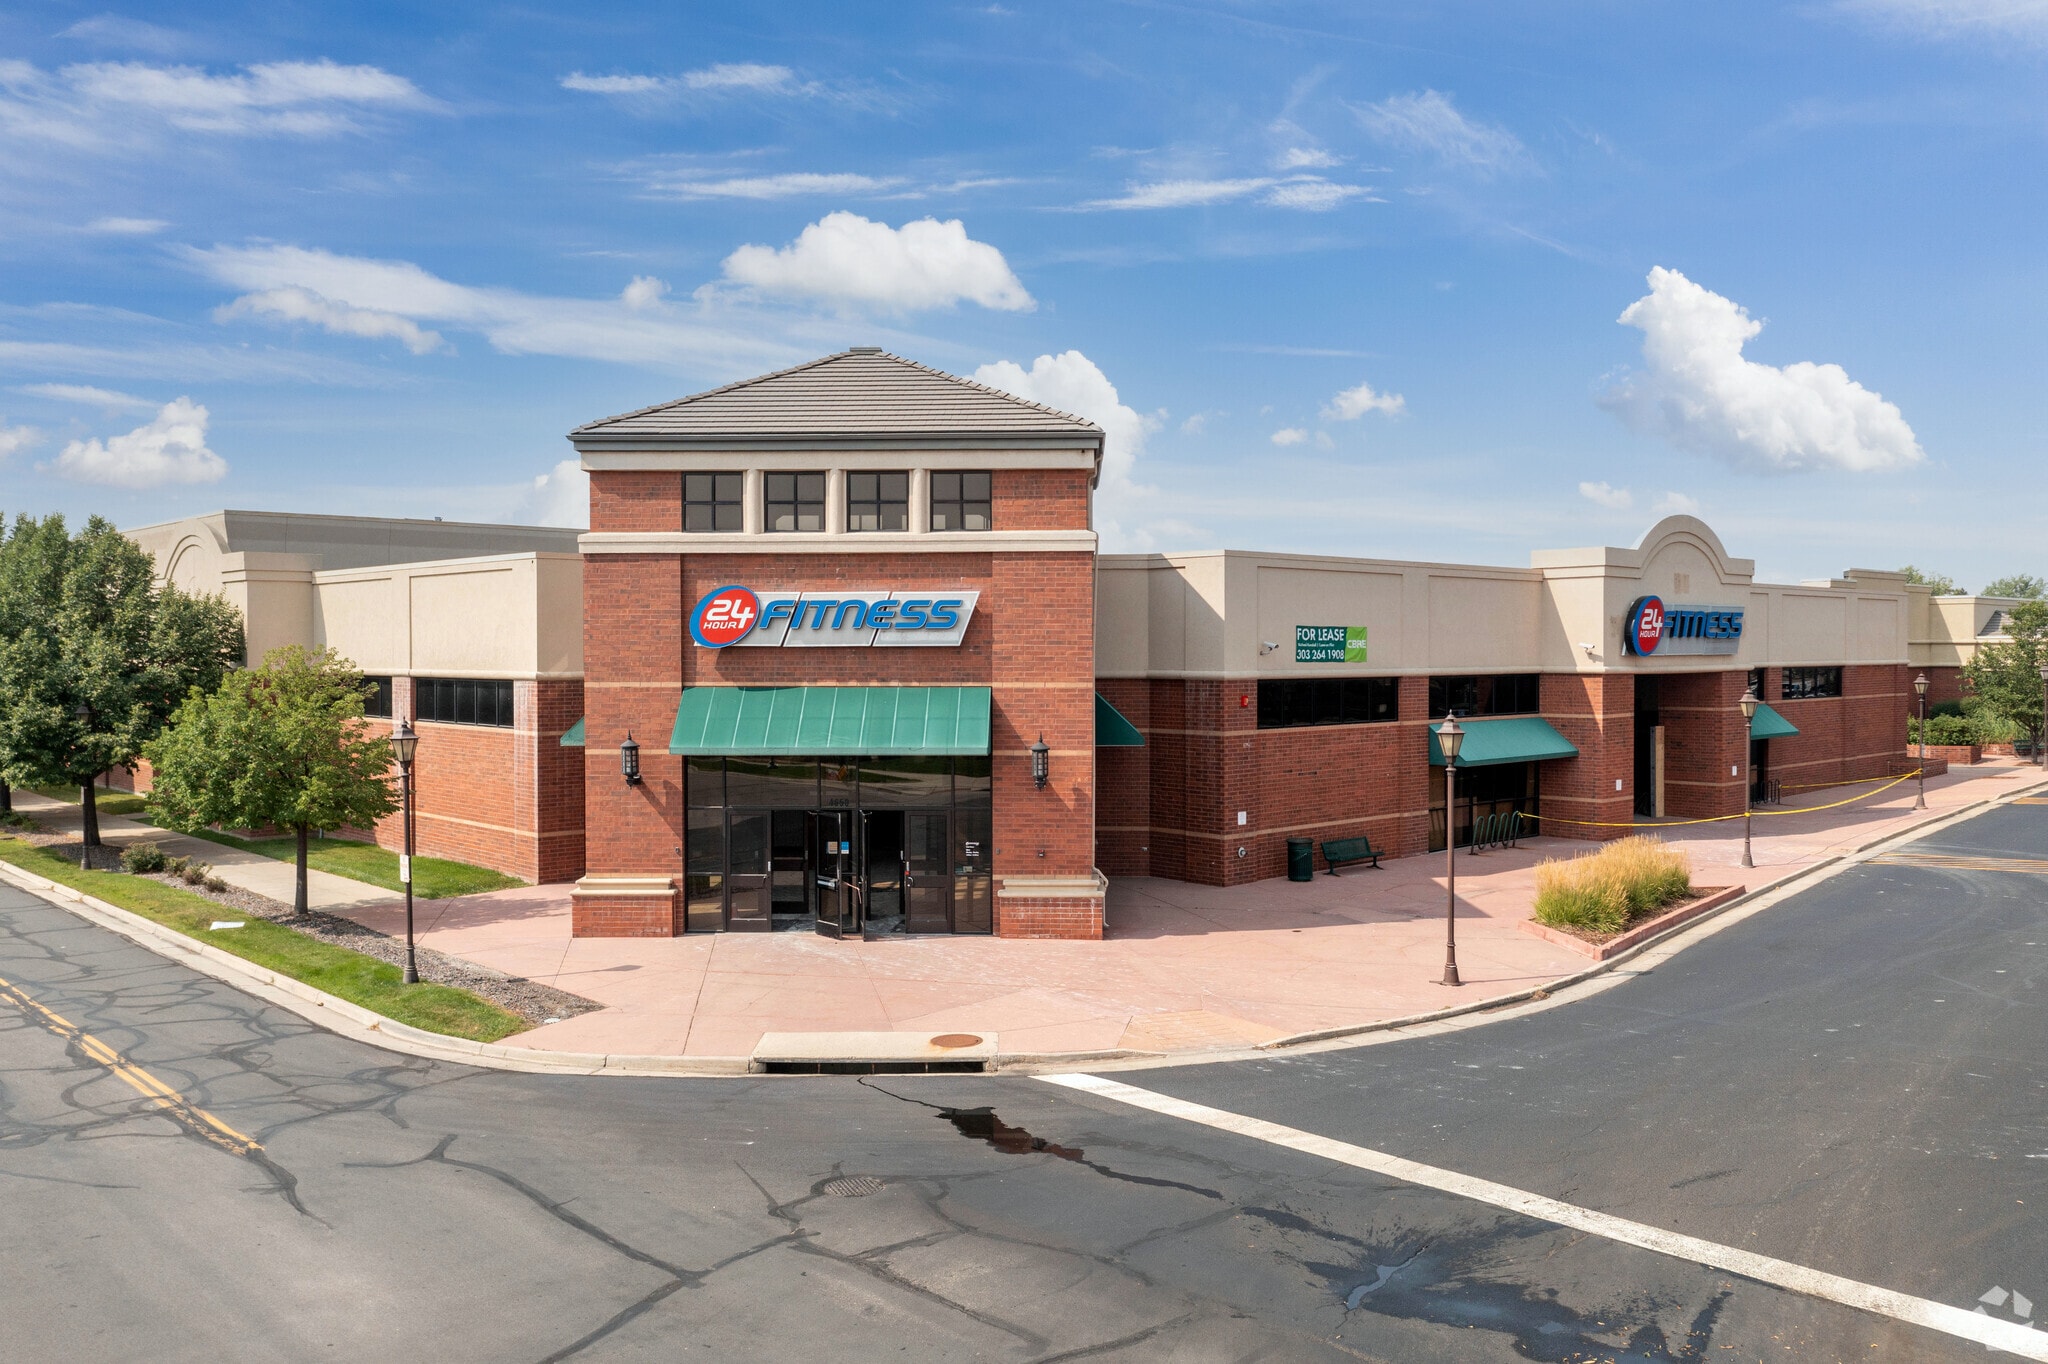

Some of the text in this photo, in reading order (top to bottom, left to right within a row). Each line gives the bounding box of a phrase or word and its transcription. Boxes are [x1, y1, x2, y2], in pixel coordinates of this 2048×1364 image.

[705, 600, 754, 629] 24
[759, 600, 962, 630] FITNESS
[703, 621, 737, 629] HOUR
[1641, 608, 1663, 637] 24
[1662, 610, 1743, 638] FITNESS
[1297, 628, 1344, 641] FOR LEASE
[1640, 630, 1656, 638] HOUR
[1347, 640, 1366, 648] CBRE
[1297, 649, 1345, 660] 303 264 1908
